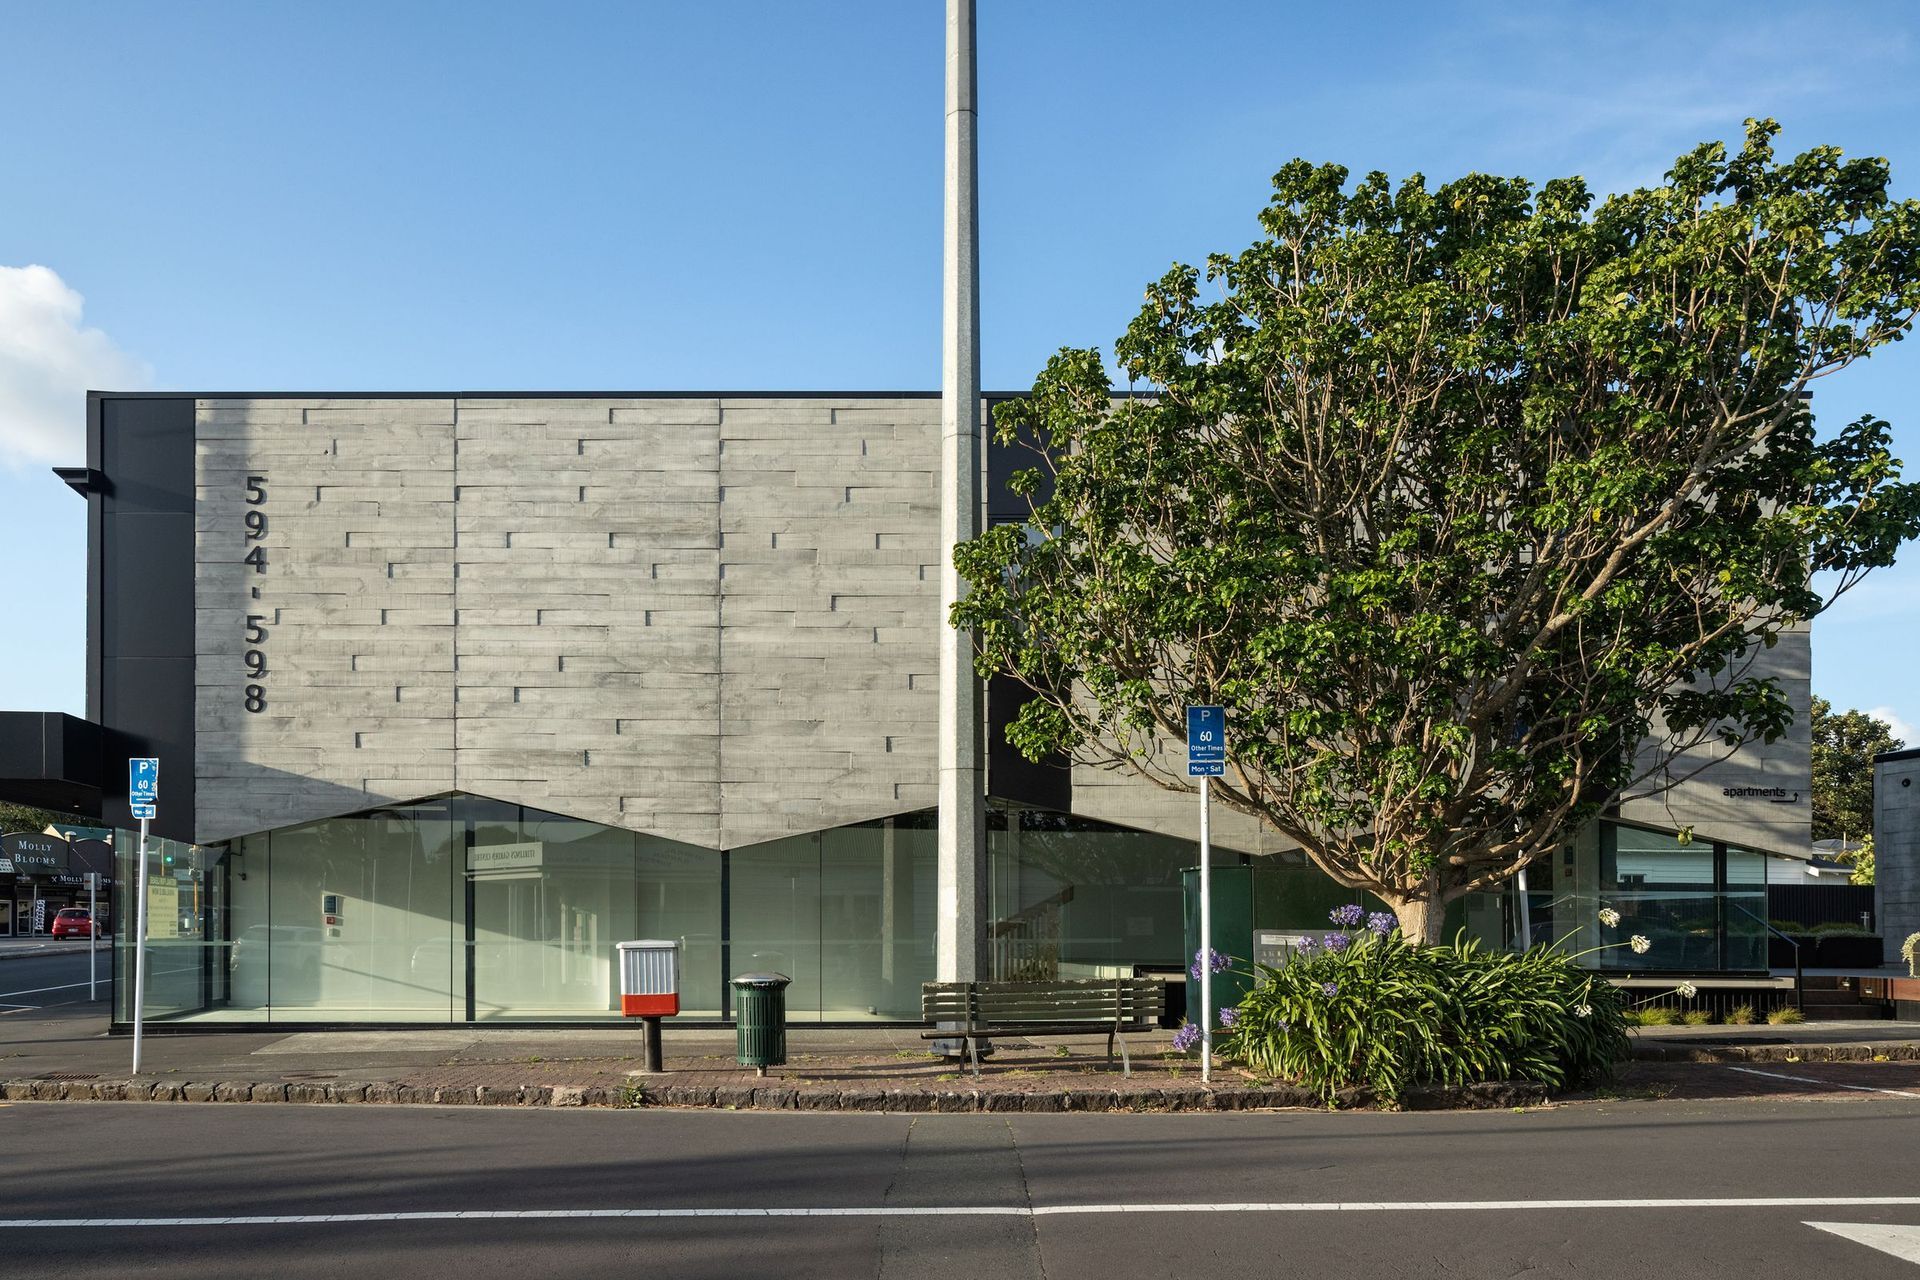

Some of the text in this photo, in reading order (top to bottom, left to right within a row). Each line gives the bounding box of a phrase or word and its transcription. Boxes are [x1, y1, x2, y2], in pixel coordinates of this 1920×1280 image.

[244, 476, 265, 713] 594-598
[1201, 710, 1210, 721] P
[1200, 731, 1212, 742] 60
[140, 761, 149, 773] P
[138, 780, 148, 789] 60
[1723, 787, 1786, 798] apartments
[18, 841, 52, 851] MOLLY
[15, 853, 56, 865] BLOOMS
